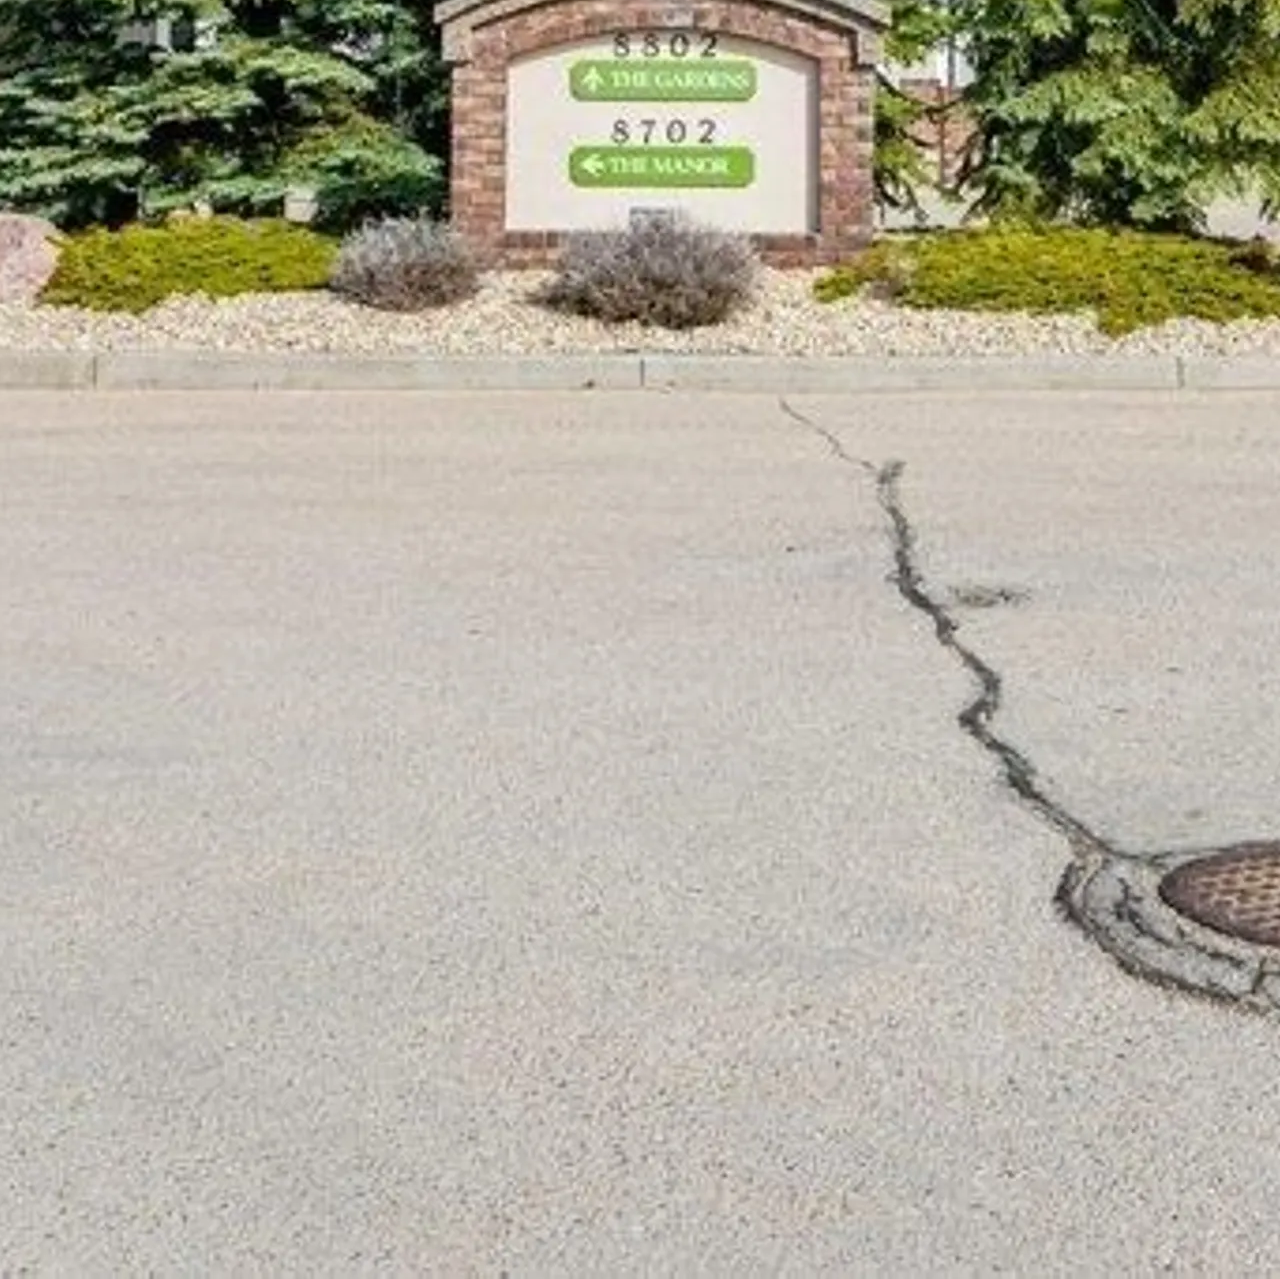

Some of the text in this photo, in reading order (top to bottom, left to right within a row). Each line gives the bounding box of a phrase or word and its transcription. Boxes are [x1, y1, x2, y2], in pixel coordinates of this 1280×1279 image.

[613, 32, 718, 58] 8802
[611, 70, 750, 90] THE GARDENS
[611, 119, 717, 144] 8702
[609, 156, 648, 174] THE
